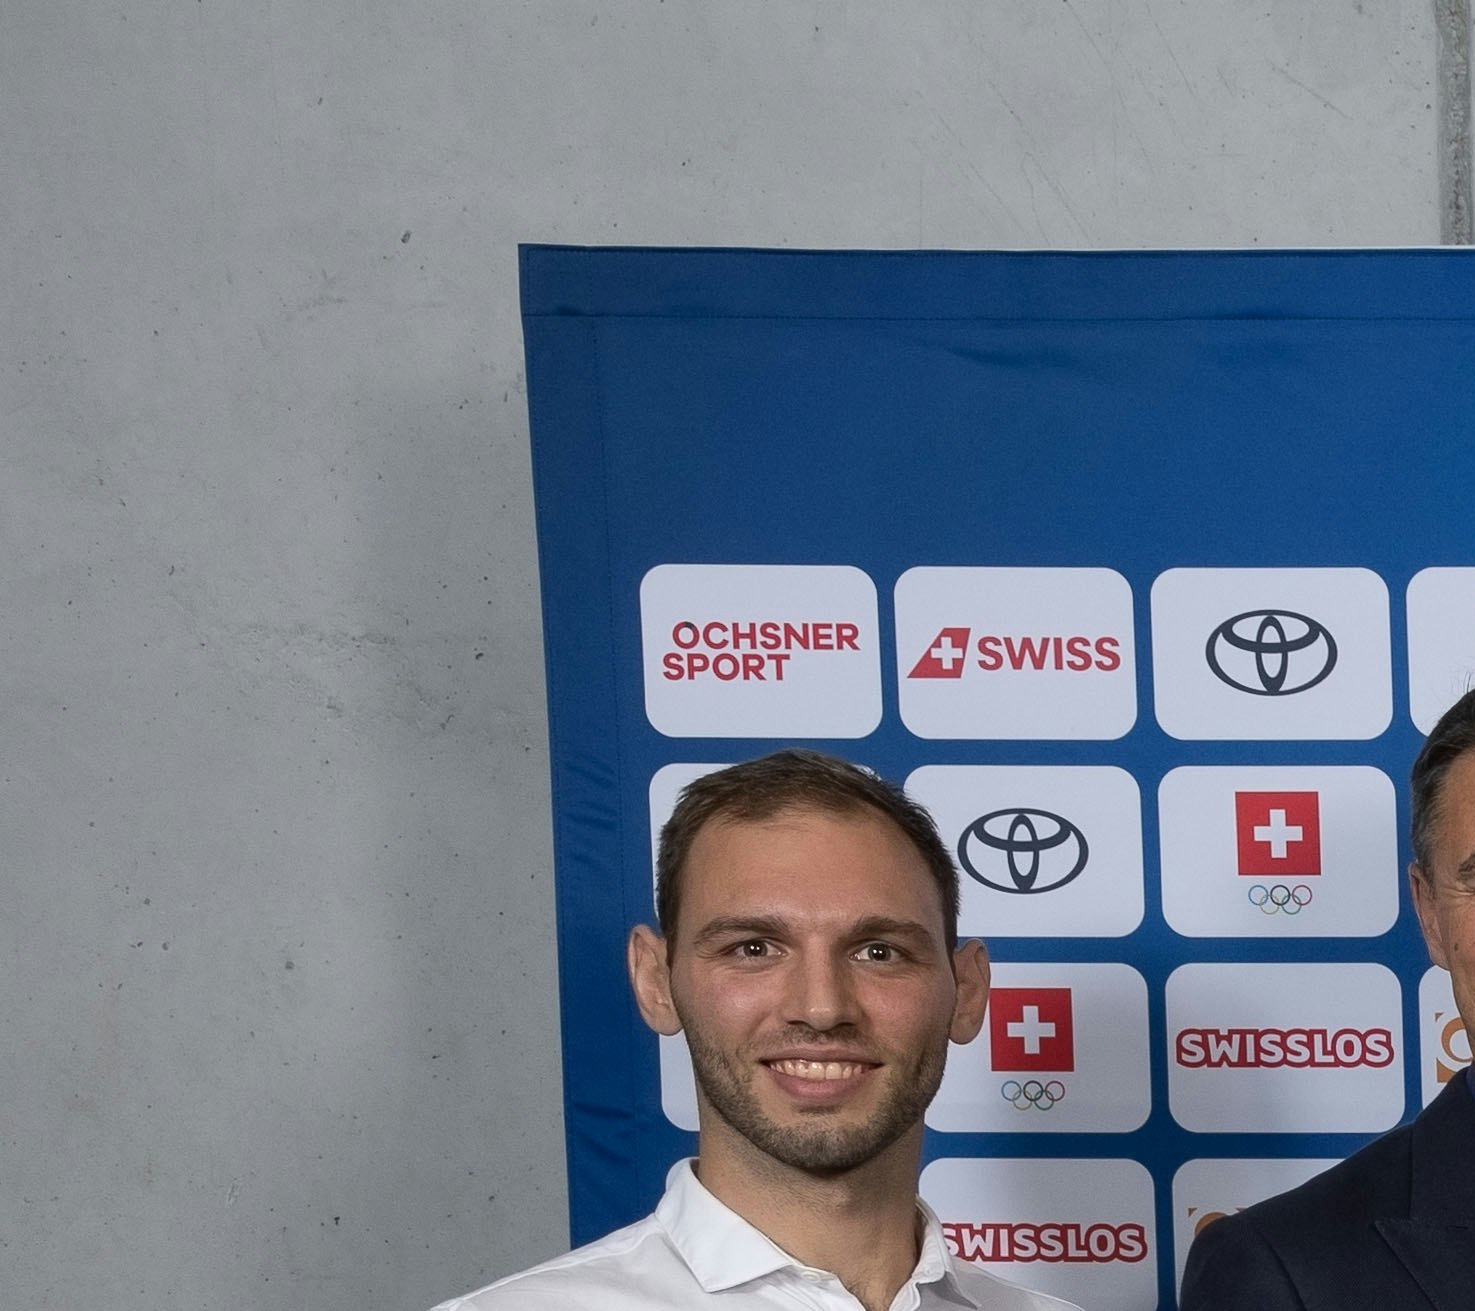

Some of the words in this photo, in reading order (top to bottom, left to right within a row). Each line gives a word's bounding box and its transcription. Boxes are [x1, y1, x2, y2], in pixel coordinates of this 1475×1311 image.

[672, 621, 860, 650] OCHSNER
[663, 653, 790, 681] SPORT
[978, 636, 1120, 671] SWISS
[1176, 1028, 1394, 1068] SWISSLOS
